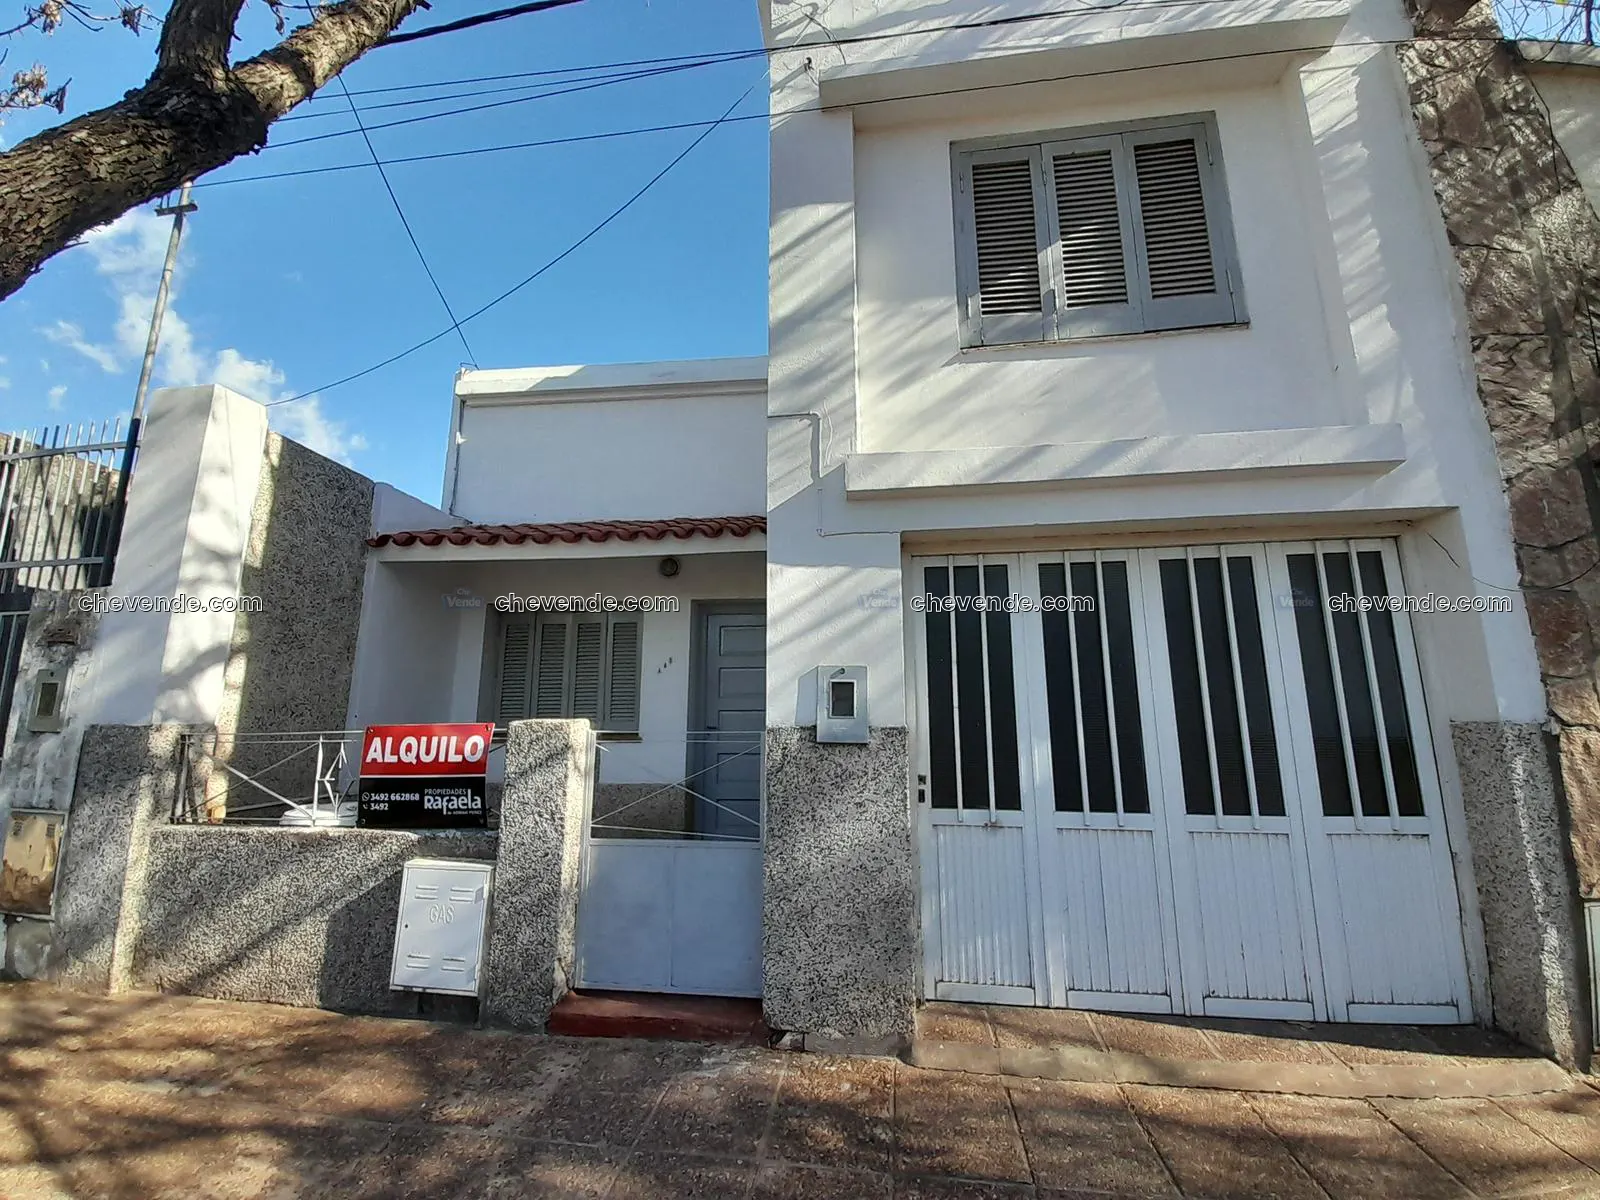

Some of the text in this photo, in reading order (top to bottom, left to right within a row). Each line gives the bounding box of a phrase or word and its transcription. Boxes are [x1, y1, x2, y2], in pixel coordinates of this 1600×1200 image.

[365, 735, 485, 765] ALQUILO
[370, 793, 389, 801] 3492
[370, 802, 389, 811] 3492
[424, 788, 482, 815] Rafaela
[429, 903, 455, 925] GAS
